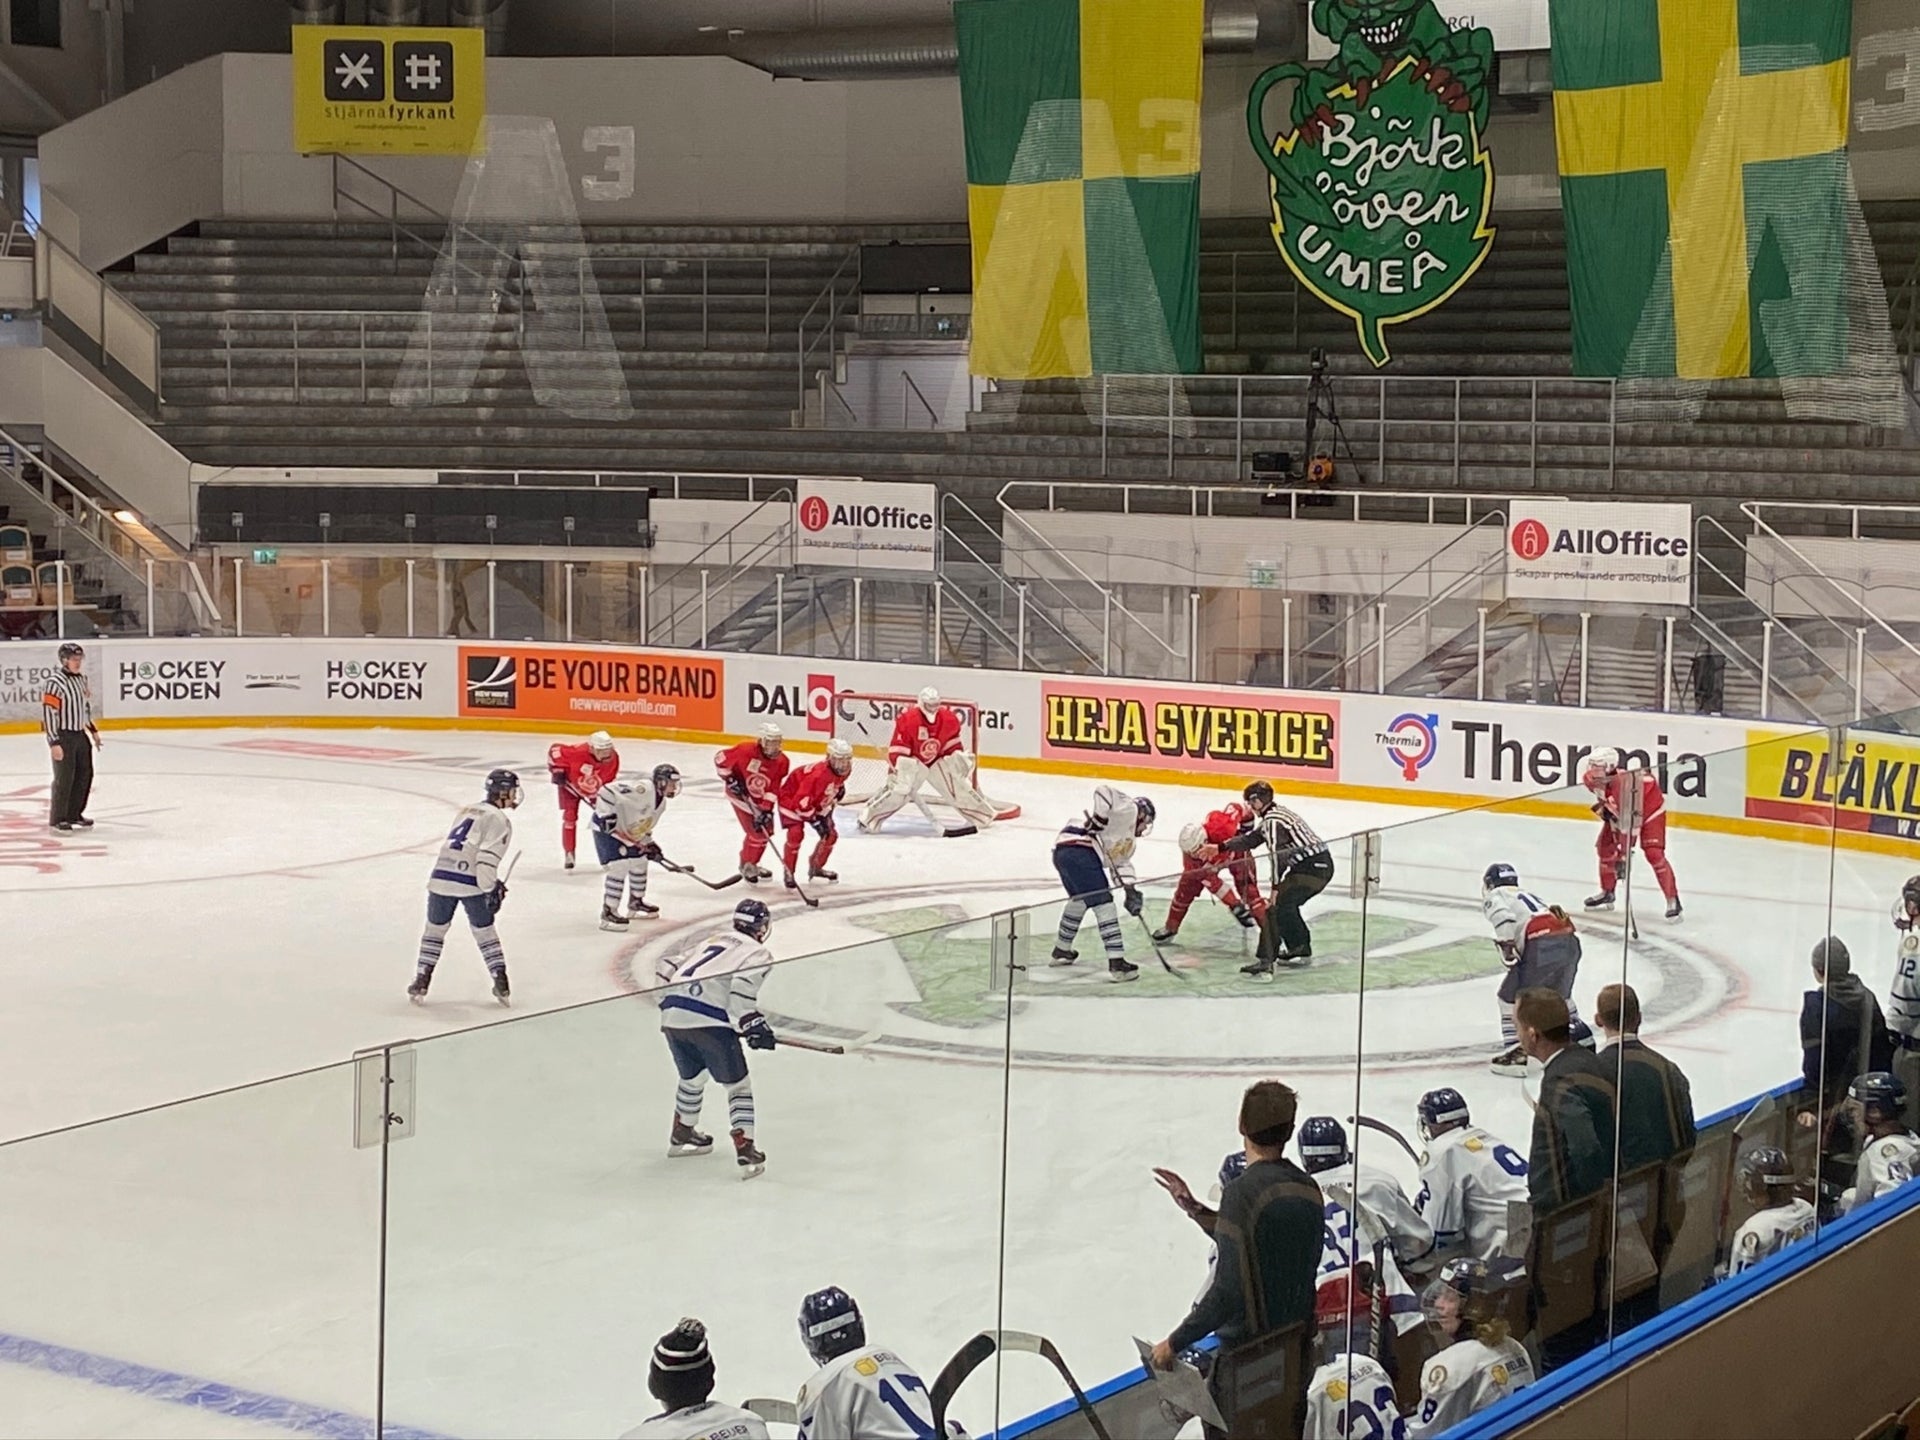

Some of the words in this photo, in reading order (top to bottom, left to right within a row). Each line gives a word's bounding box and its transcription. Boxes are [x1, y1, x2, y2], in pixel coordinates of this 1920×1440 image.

[325, 103, 456, 121] stjärnafyrkant
[1298, 225, 1448, 294] UMEÅ
[831, 504, 933, 530] AllOffice
[1552, 529, 1688, 557] AllOffice
[120, 682, 220, 701] FONDEN
[327, 681, 423, 700] FONDEN
[525, 658, 556, 688] BE
[562, 660, 630, 694] YOUR
[636, 664, 717, 699] BRAND
[570, 697, 677, 716] newwaveprofile.com
[1047, 695, 1150, 753] HEJA
[1155, 702, 1333, 767] SVERIGE
[1375, 733, 1422, 748] Thermia
[447, 817, 475, 851] 4
[681, 945, 727, 977] 7
[1899, 957, 1916, 979] 12
